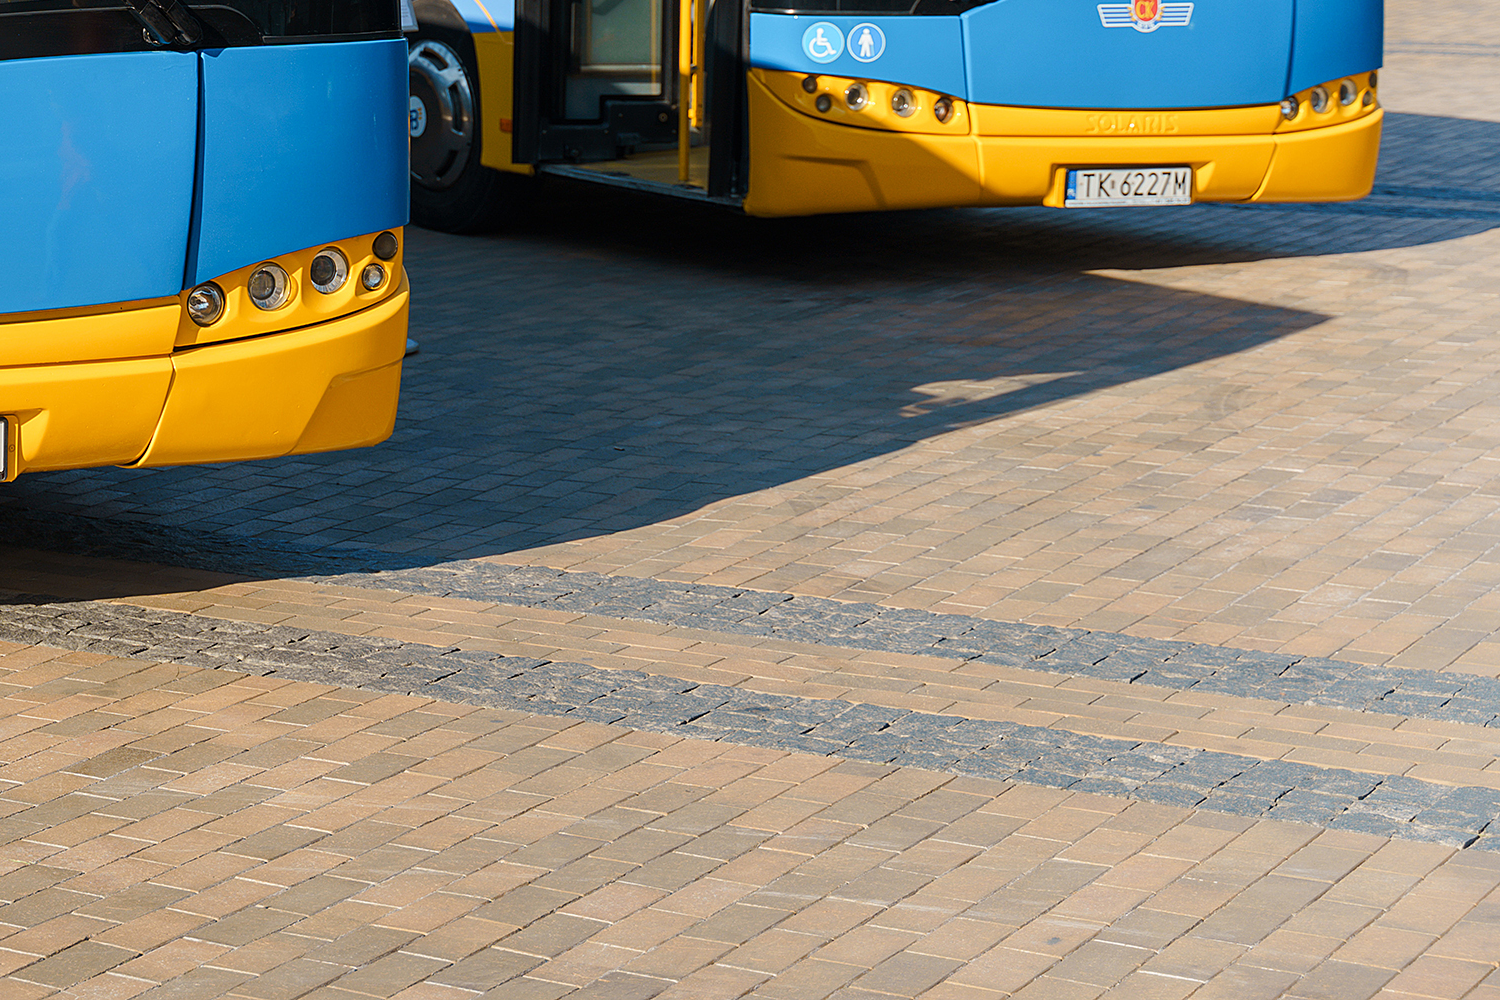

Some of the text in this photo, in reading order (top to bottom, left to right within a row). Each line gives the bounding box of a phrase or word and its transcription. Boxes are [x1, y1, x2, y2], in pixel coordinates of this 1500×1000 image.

[1085, 114, 1179, 134] SOLARIS
[1083, 172, 1111, 198] TK
[1120, 171, 1187, 197] 6227M
